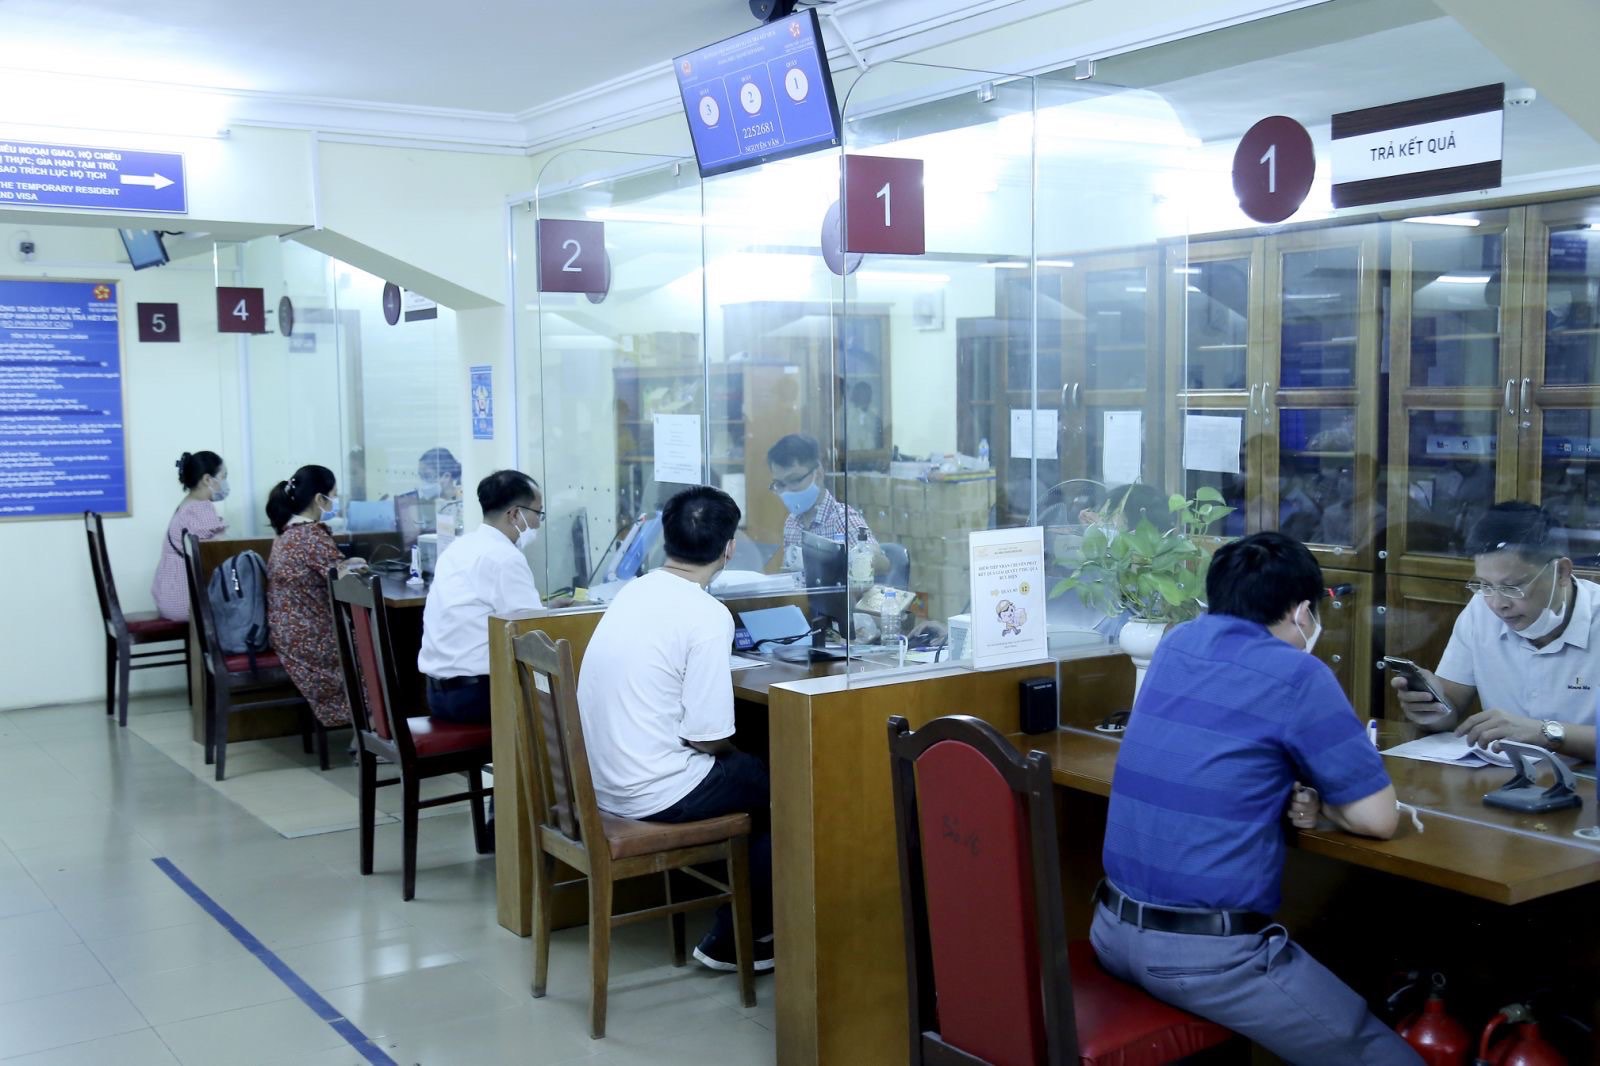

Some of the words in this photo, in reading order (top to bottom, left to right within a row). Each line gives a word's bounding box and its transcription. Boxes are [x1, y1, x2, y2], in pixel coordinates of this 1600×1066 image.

[793, 77, 800, 90] 1
[747, 91, 755, 104] 2
[706, 104, 713, 116] 3
[743, 121, 775, 139] 2252681
[1370, 140, 1395, 161] TRẢ
[1399, 136, 1424, 157] KẾT
[1428, 130, 1457, 154] QUẢ
[19, 147, 50, 157] NGOẠI
[79, 152, 93, 160] HỘ
[36, 158, 52, 166] GIA
[54, 160, 74, 169] HẠN
[76, 161, 96, 170] TẠM
[1259, 144, 1276, 193] 1
[19, 166, 48, 175] TRÍCH
[50, 170, 68, 178] LỤC
[70, 171, 84, 179] HỘ
[86, 172, 107, 180] TỊCH
[16, 183, 74, 193] TEMPORARY
[76, 186, 120, 195] RESIDENT
[16, 192, 38, 201] VISA
[876, 182, 893, 227] 1
[561, 239, 583, 272] 2
[232, 299, 249, 321] 4
[152, 313, 167, 333] 5
